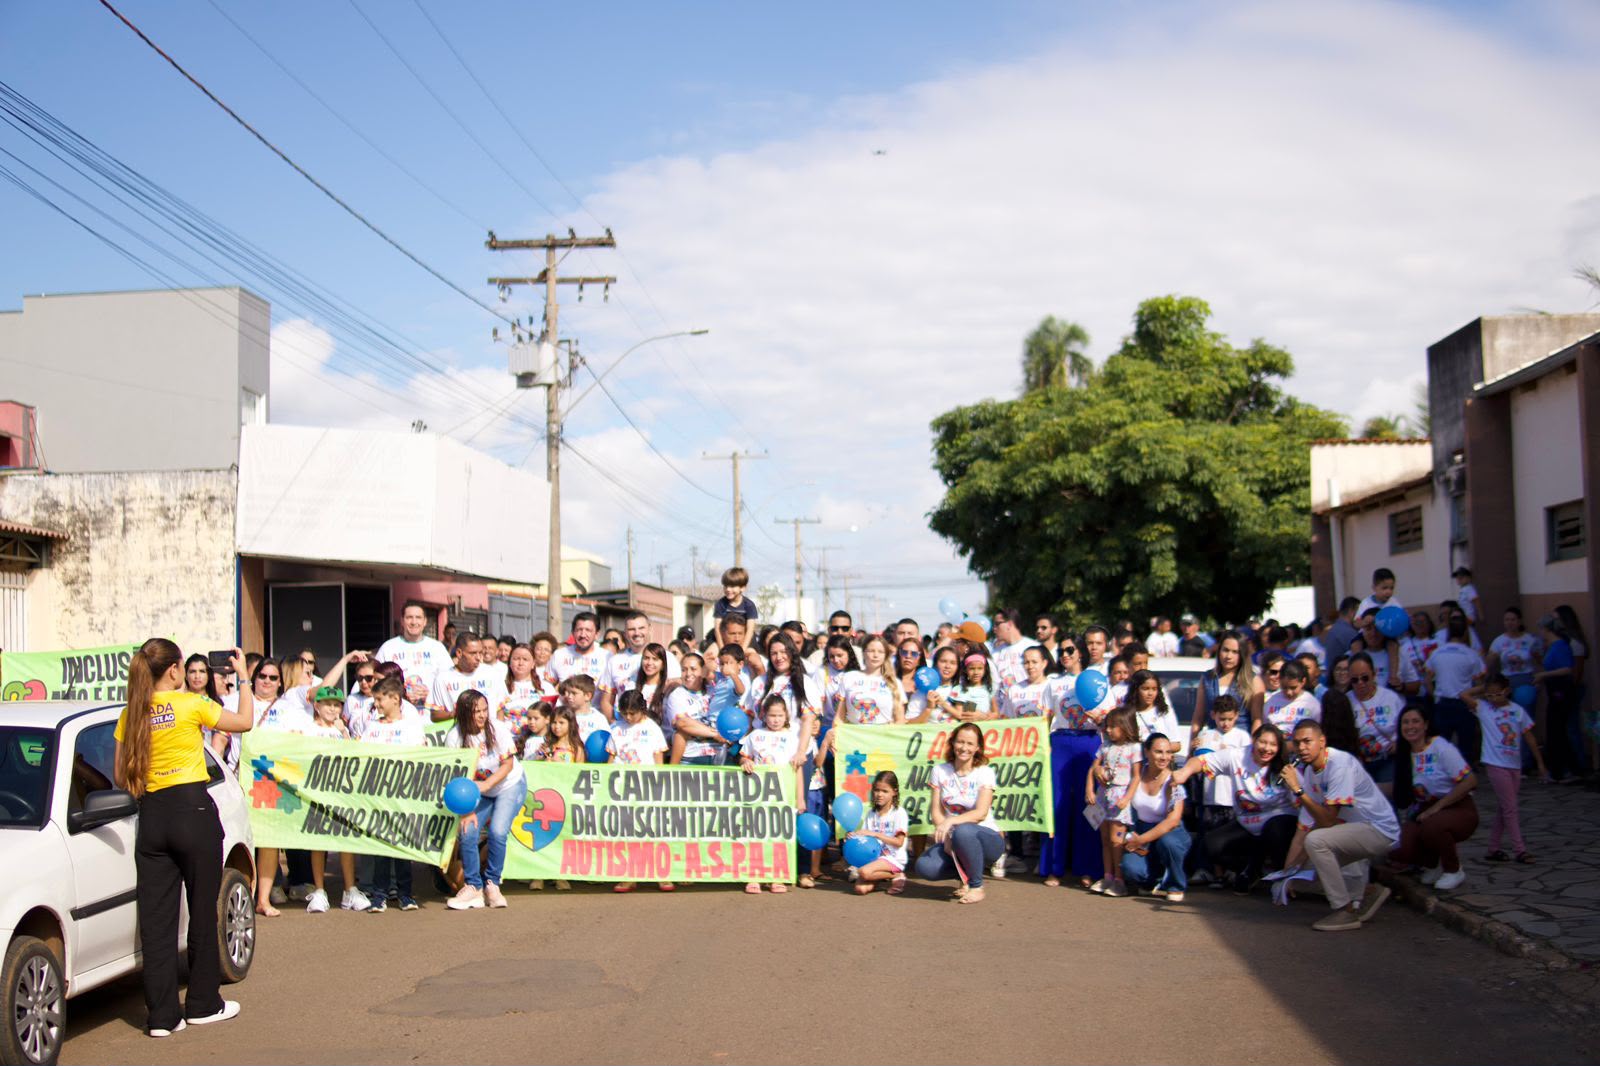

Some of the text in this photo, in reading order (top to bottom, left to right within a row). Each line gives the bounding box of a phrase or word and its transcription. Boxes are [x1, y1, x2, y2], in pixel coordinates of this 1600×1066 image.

[60, 651, 131, 685] INCLUS
[149, 702, 174, 716] ADA
[906, 727, 1039, 760] O ASMO
[303, 754, 360, 795] MAIS
[571, 770, 783, 803] 4ª CAMINHADA
[905, 760, 934, 791] NÃ
[300, 800, 366, 838] MENOS
[571, 803, 794, 841] DA CONSCIENTIZAÇÃO DO
[560, 839, 672, 879] AUTISMO
